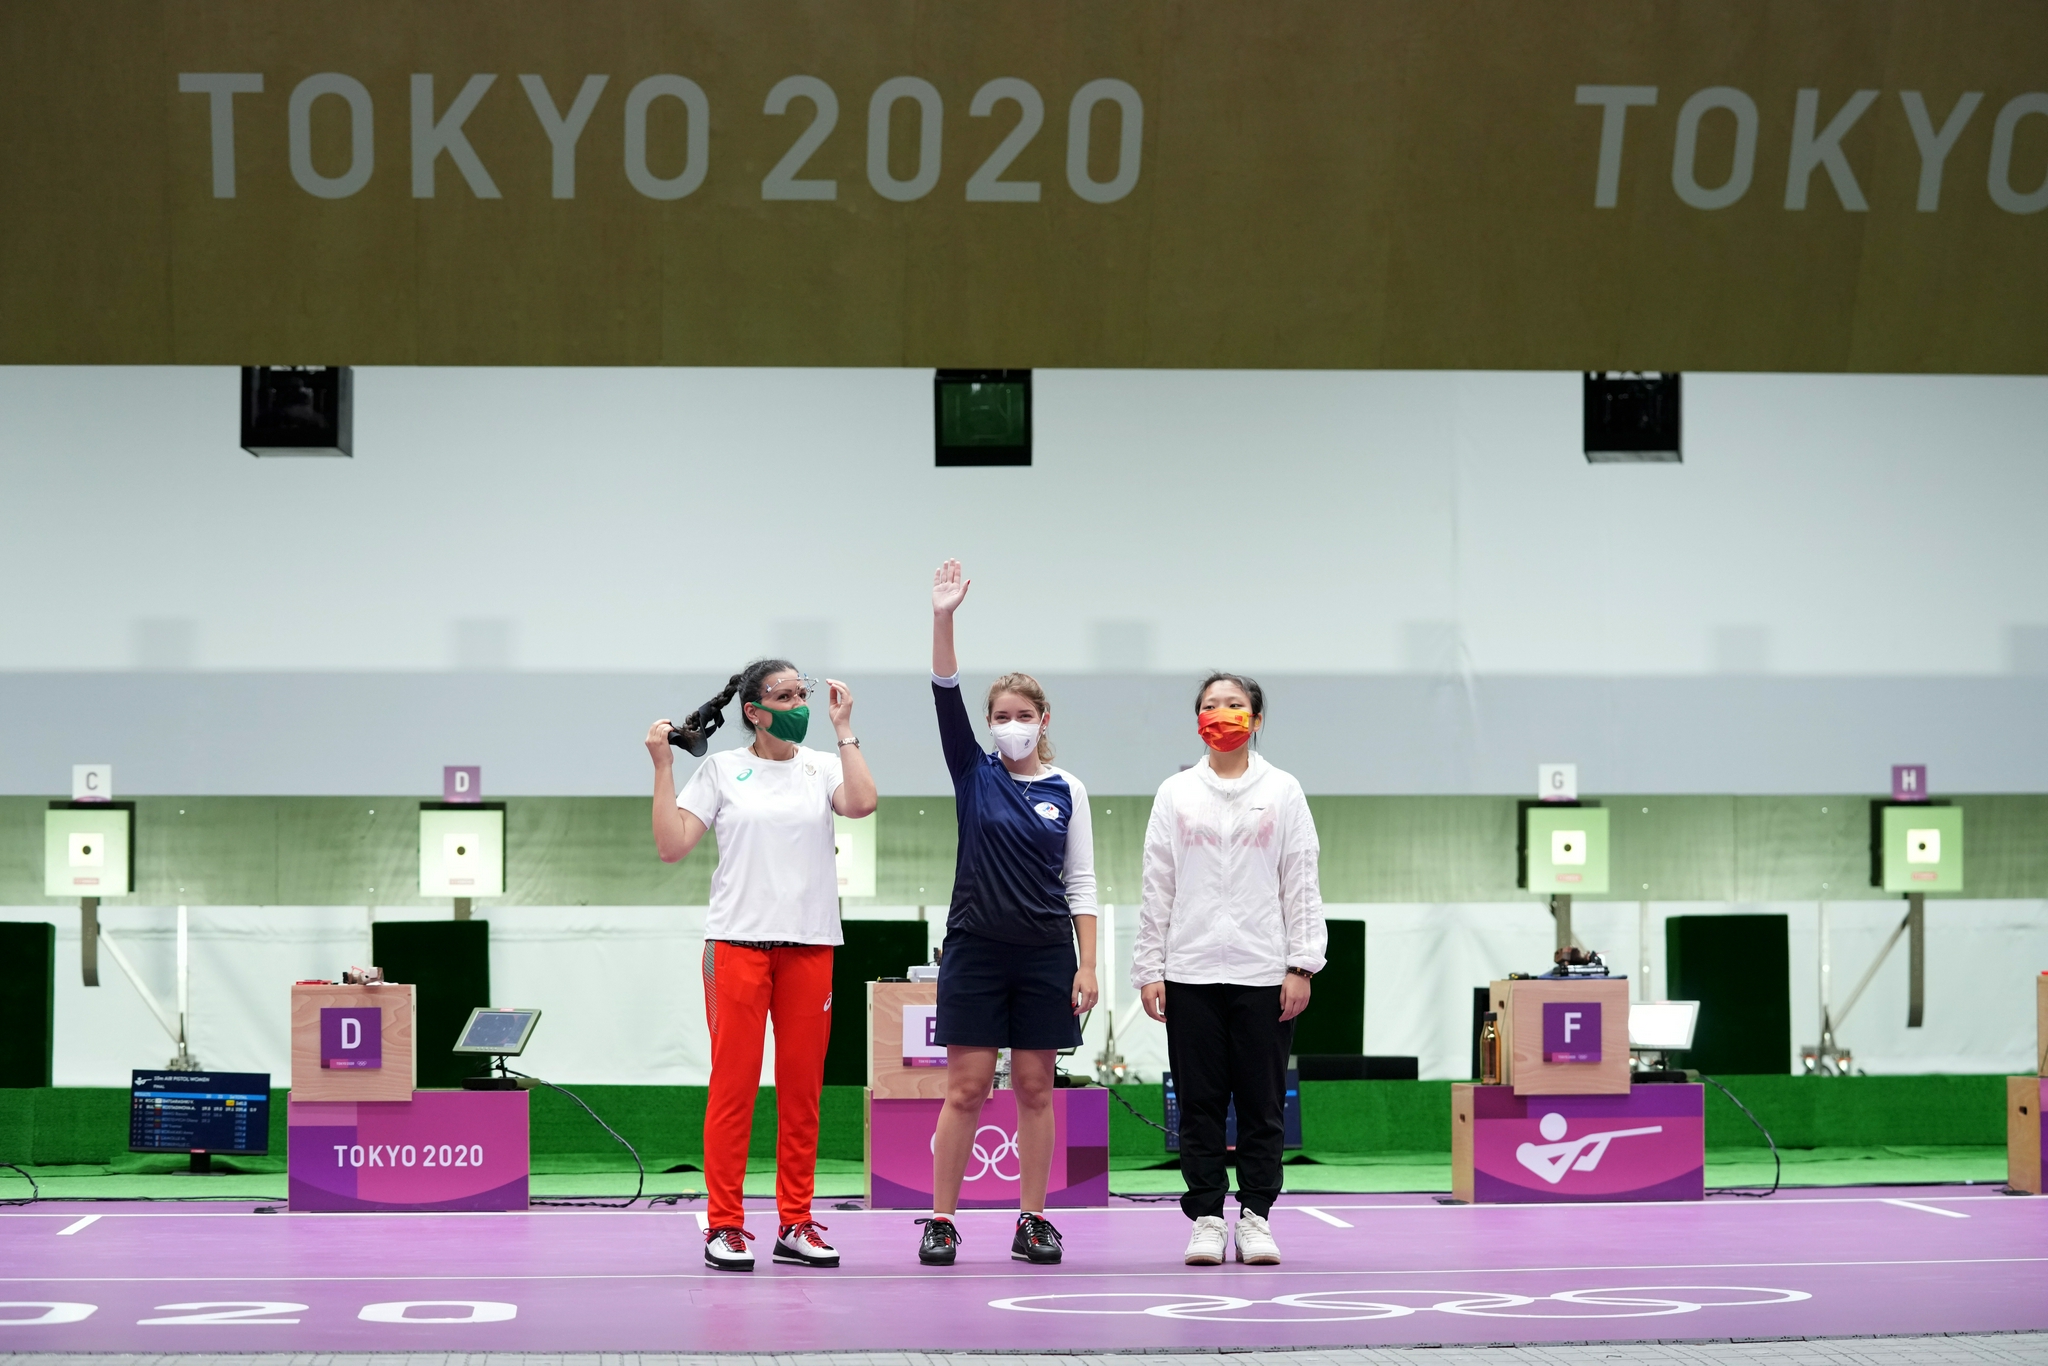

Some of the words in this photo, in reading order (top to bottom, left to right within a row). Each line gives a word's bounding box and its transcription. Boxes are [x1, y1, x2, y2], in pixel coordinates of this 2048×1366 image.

[178, 72, 710, 200] TOKYO
[761, 74, 1145, 203] 2020
[1574, 84, 2048, 215] TOKYO
[85, 771, 98, 791] C
[454, 771, 470, 793] D
[1551, 770, 1564, 790] G
[1902, 769, 1917, 792] H
[341, 1017, 361, 1049] D
[1564, 1012, 1582, 1043] F
[333, 1145, 416, 1167] TOKYO
[422, 1144, 484, 1167] 2020
